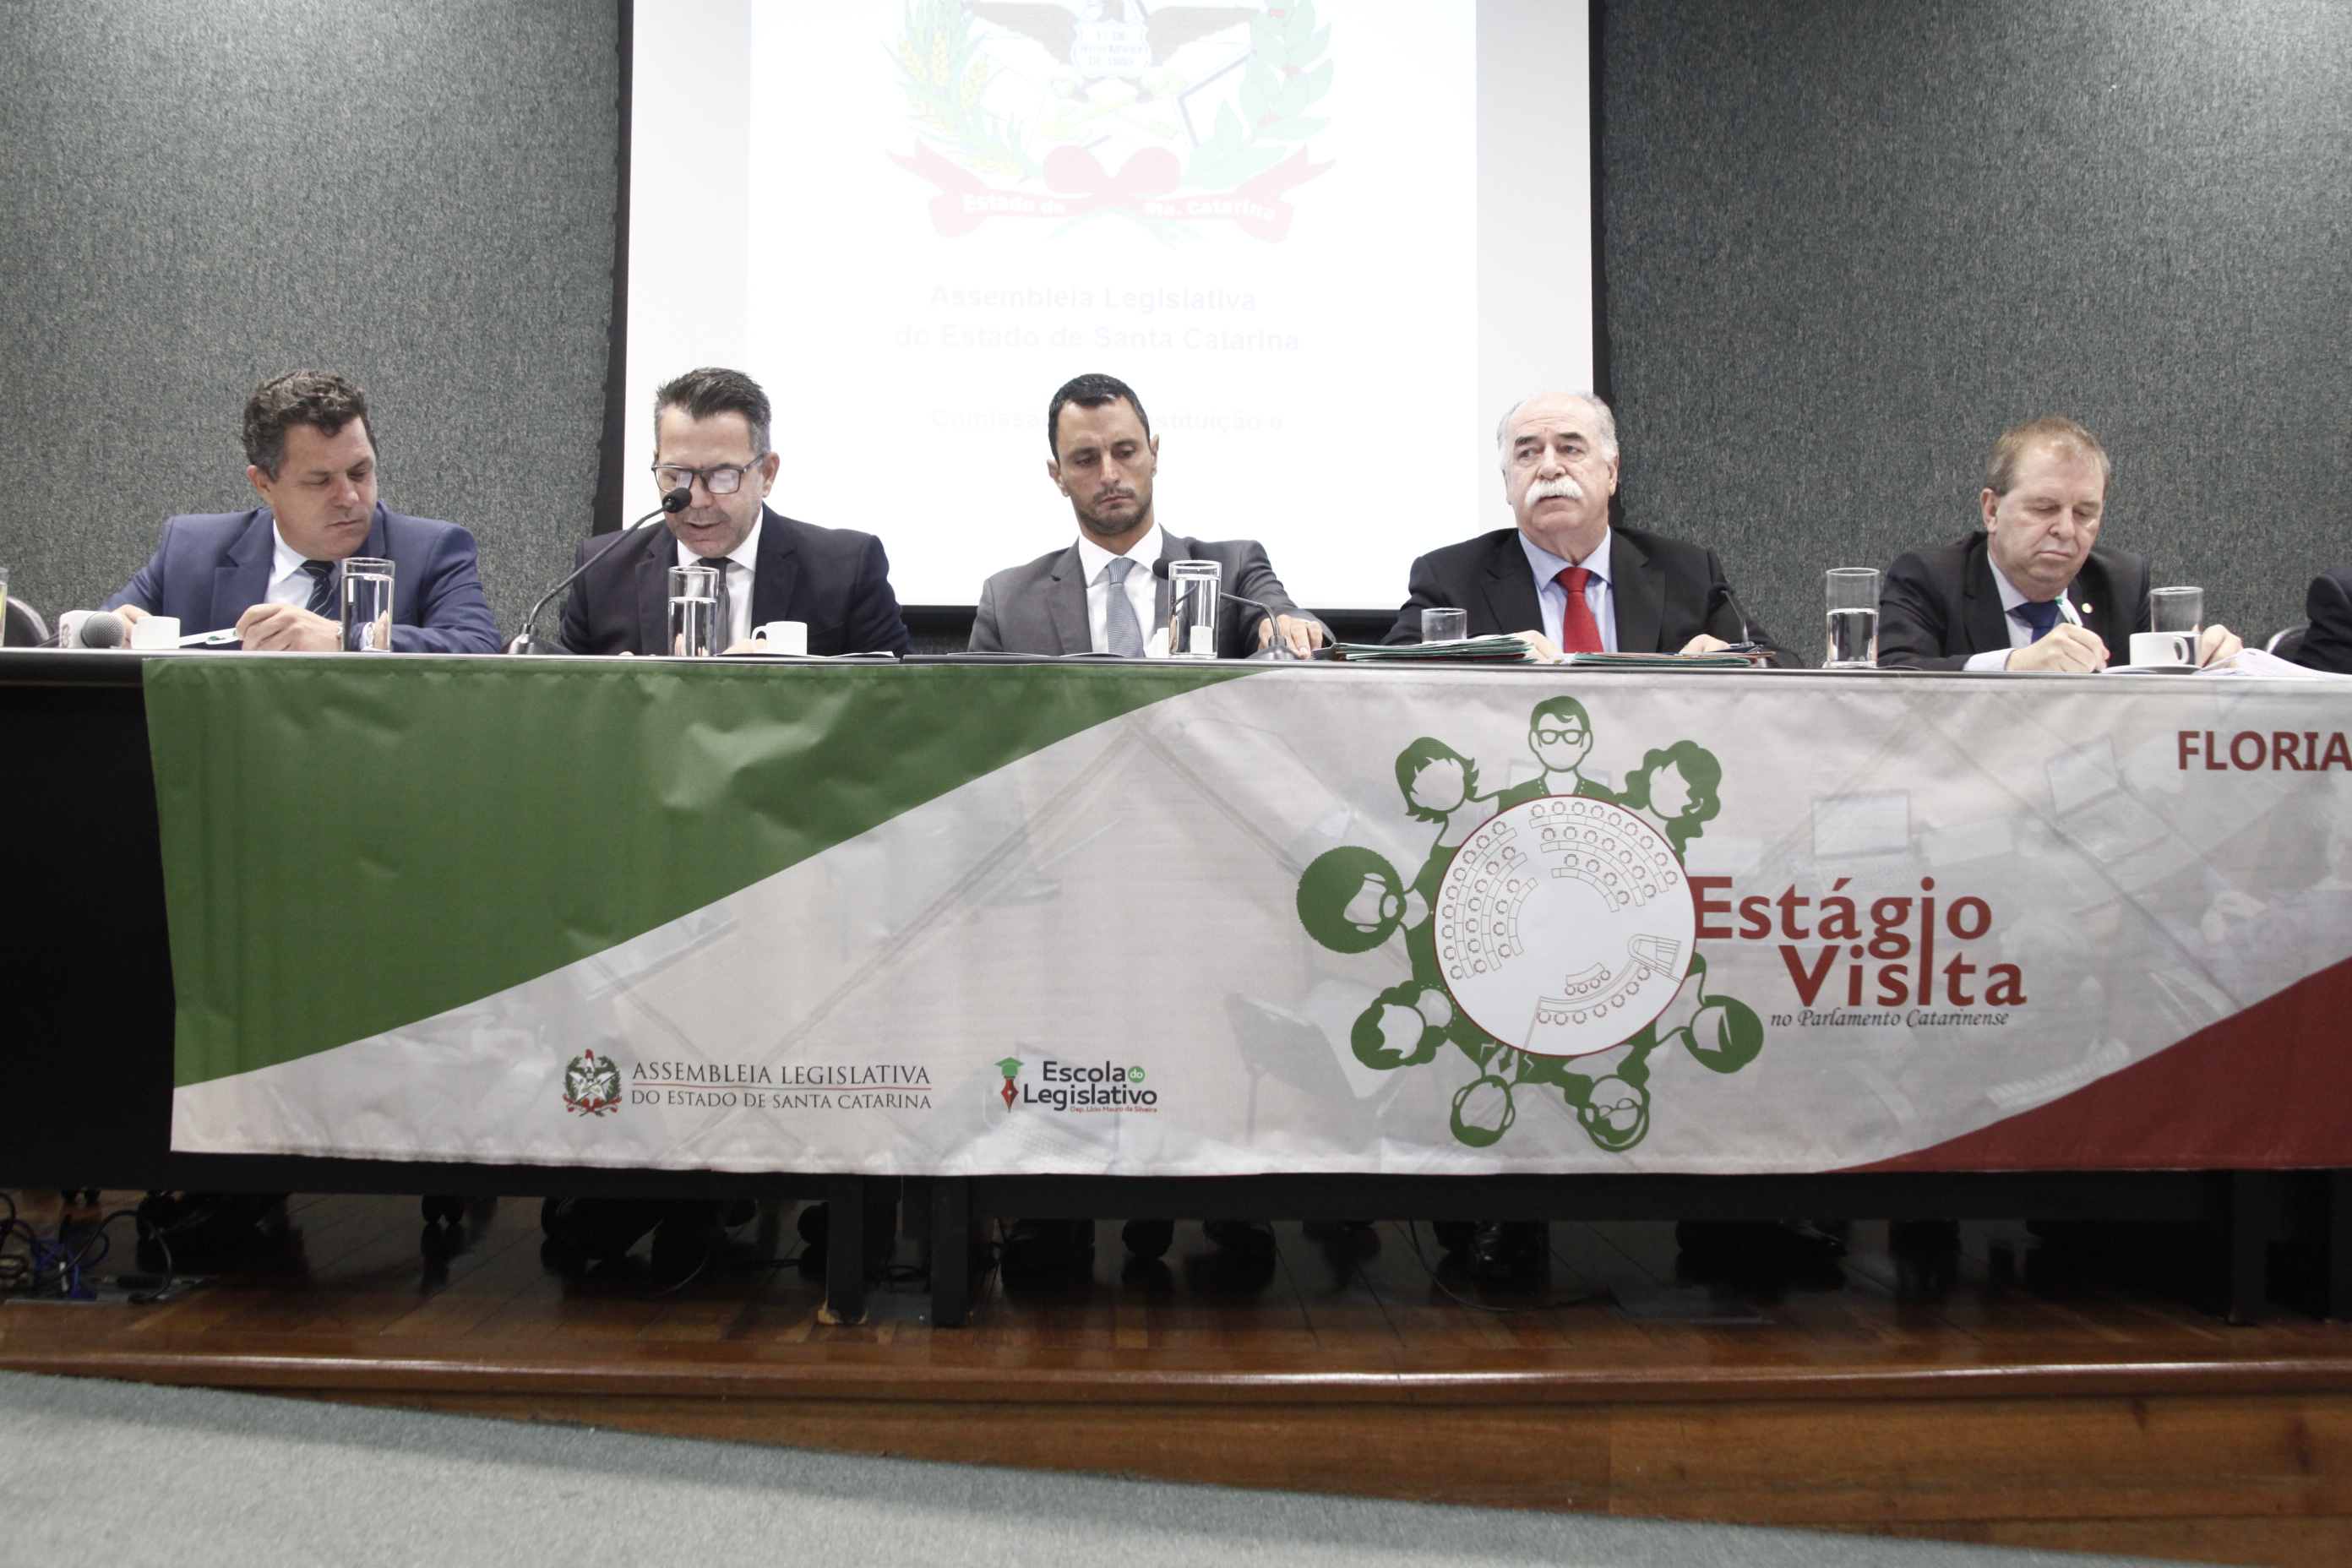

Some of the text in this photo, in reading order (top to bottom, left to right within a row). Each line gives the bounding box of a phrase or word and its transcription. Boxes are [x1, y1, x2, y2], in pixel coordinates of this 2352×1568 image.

[1097, 30, 1128, 41] 17 DE
[1088, 56, 1102, 67] DE
[963, 193, 1277, 220] Estado de Sta. Catarina
[930, 284, 1257, 315] Assembleia Legislativa
[895, 324, 1300, 352] do Estado de Santa Catarina
[1270, 417, 1285, 432] e
[2177, 730, 2352, 771] FLORIA
[1688, 875, 1993, 961] Estágio
[1770, 1008, 2010, 1028] no Parlamento Catarinense
[632, 1061, 931, 1085] ASSEMBLEIA LEGISLATIVA
[1043, 1060, 1144, 1083] Escola do
[631, 1090, 932, 1109] DO ESTADO DE SANTA CATARINA
[1023, 1083, 1157, 1112] Legislativo
